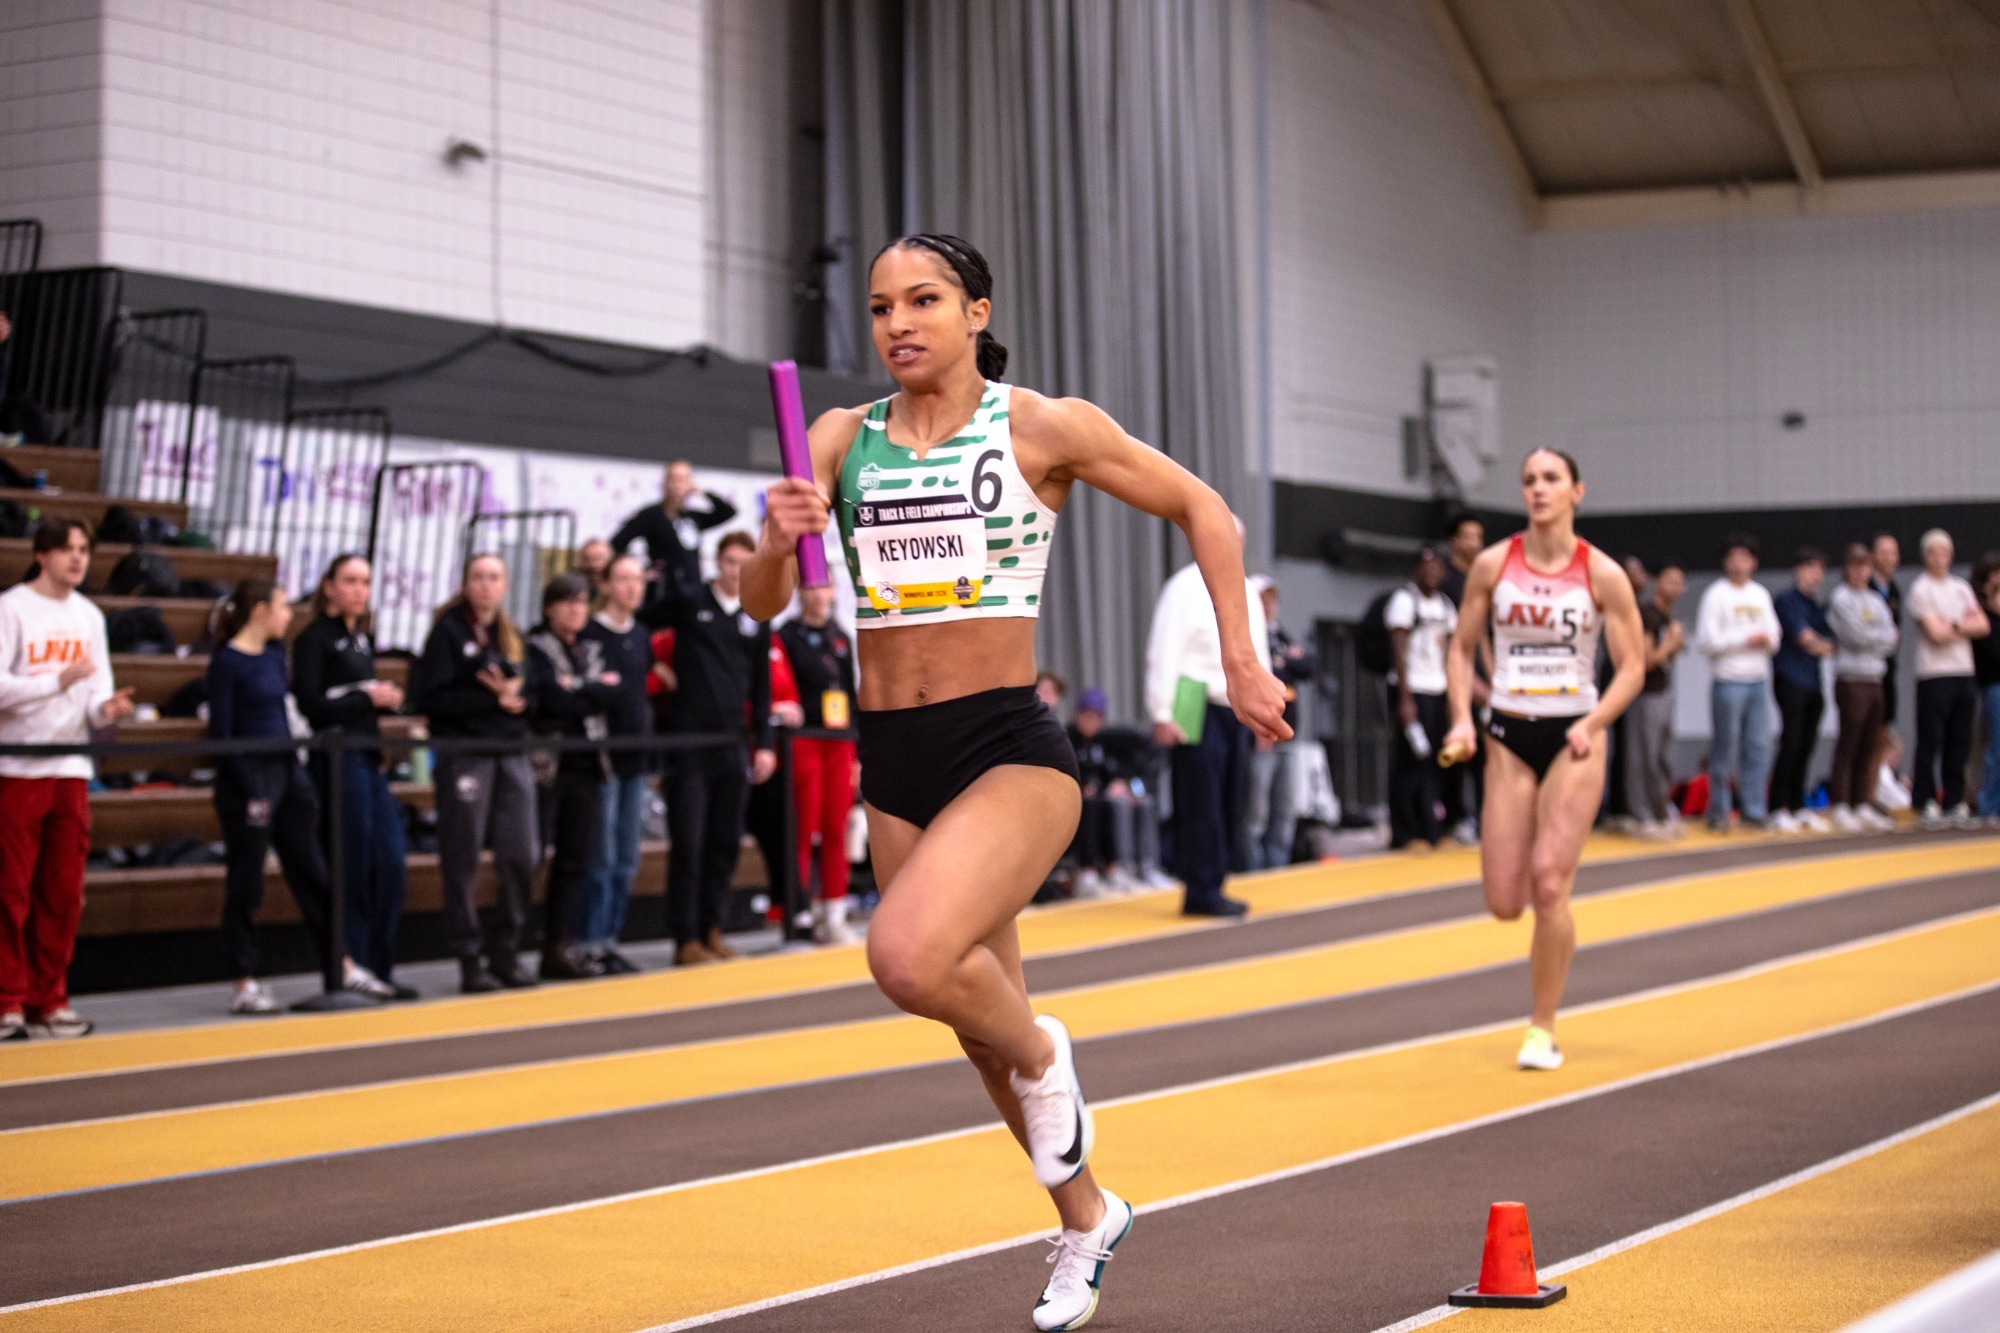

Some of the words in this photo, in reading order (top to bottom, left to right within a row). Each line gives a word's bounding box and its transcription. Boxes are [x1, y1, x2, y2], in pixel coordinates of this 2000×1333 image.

[971, 449, 1004, 513] 6
[878, 507, 899, 521] TRACK
[899, 507, 906, 520] &
[906, 505, 922, 519] FIELD
[922, 501, 971, 518] CHAMPIONSHIPS
[877, 535, 964, 562] KEYOWSKI
[1562, 608, 1577, 642] 5
